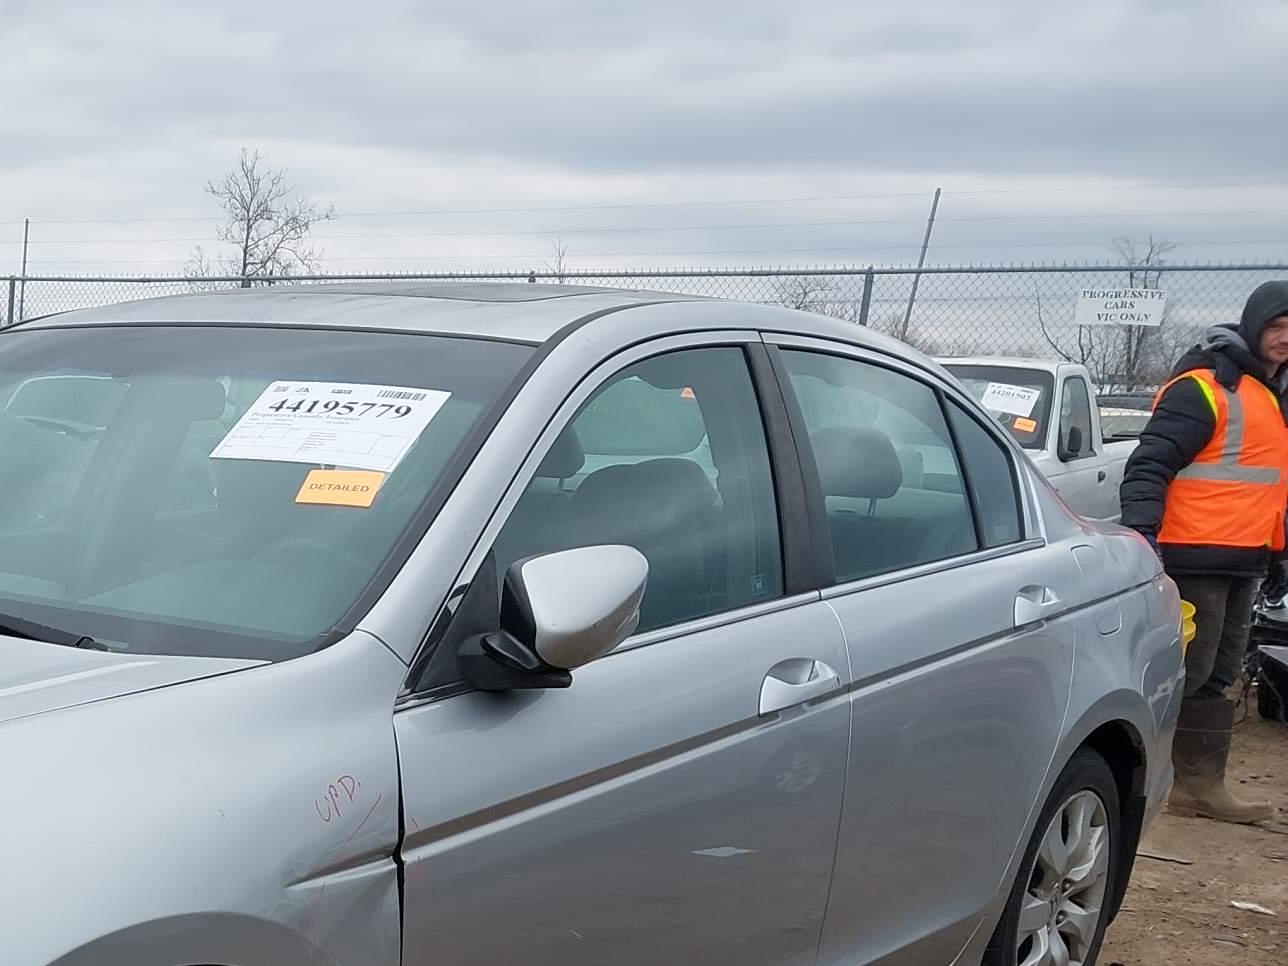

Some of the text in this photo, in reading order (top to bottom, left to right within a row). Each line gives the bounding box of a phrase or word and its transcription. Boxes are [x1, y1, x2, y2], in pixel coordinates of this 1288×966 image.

[1082, 290, 1165, 300] PROGRESSIVE
[1104, 301, 1136, 310] CARS
[1120, 313, 1151, 322] ONLY
[269, 398, 412, 419] 44195779
[309, 482, 370, 493] DETAILED
